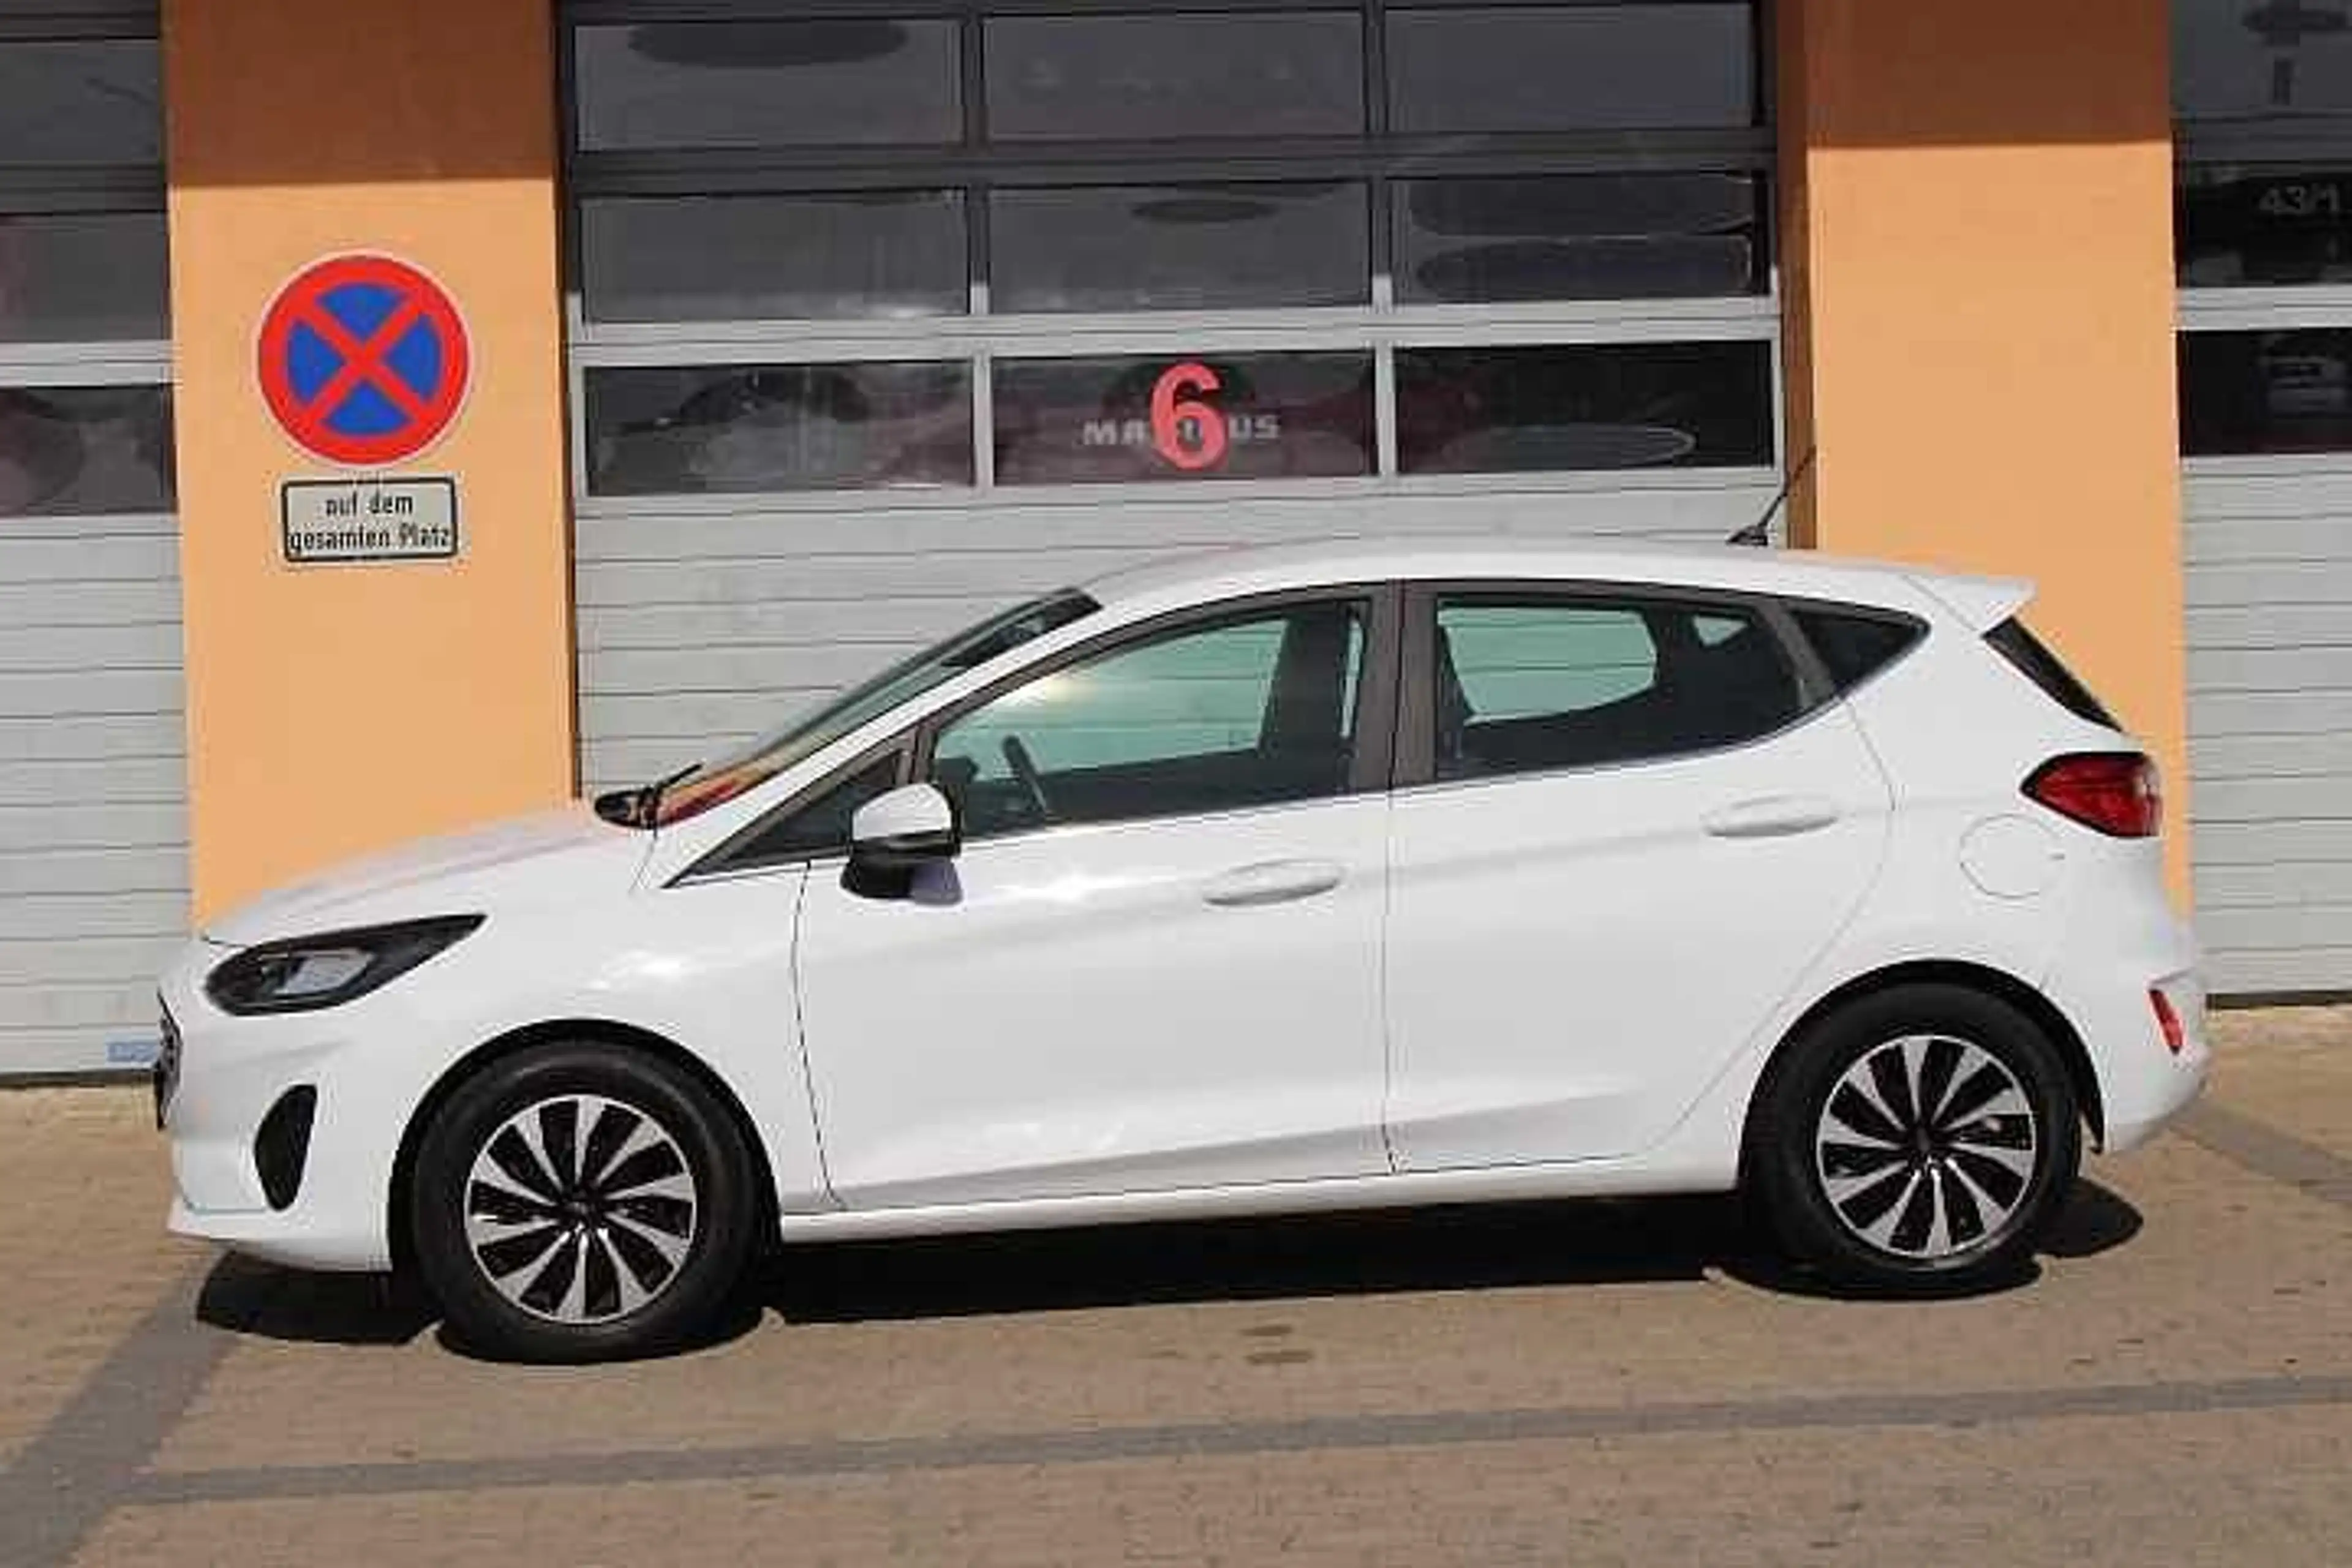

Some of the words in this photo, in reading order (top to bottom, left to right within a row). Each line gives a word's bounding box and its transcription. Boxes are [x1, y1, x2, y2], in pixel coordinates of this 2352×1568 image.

[1152, 363, 1224, 470] 6
[326, 491, 357, 516] auf
[369, 489, 413, 514] dem
[288, 526, 390, 553] gesamten
[398, 524, 450, 547] Platz
